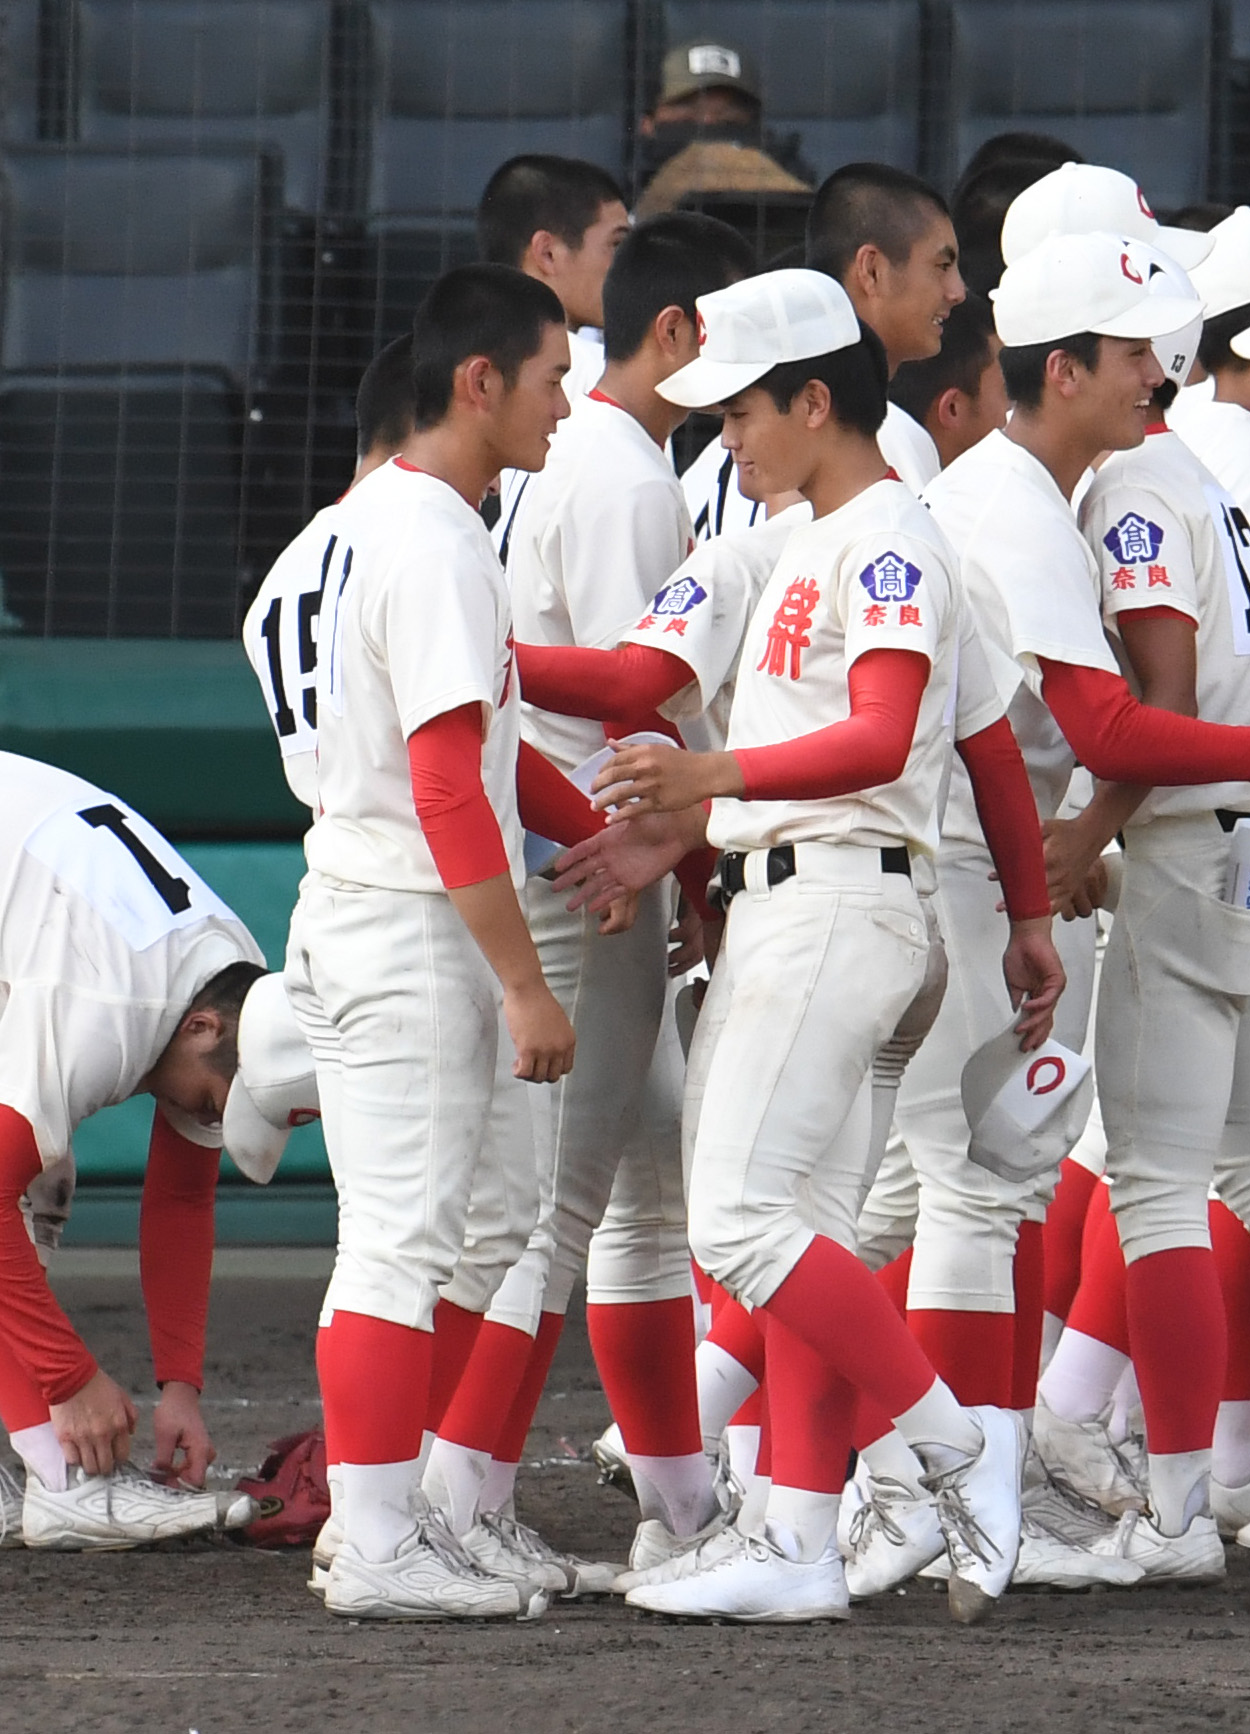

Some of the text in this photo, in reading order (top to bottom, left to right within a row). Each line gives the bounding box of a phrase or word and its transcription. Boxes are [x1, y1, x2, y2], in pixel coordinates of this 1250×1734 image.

[1170, 353, 1187, 374] 13
[1110, 564, 1171, 591] 奈良
[862, 604, 923, 627] 奈良
[75, 803, 192, 915] 1
[1027, 1056, 1066, 1096] C
